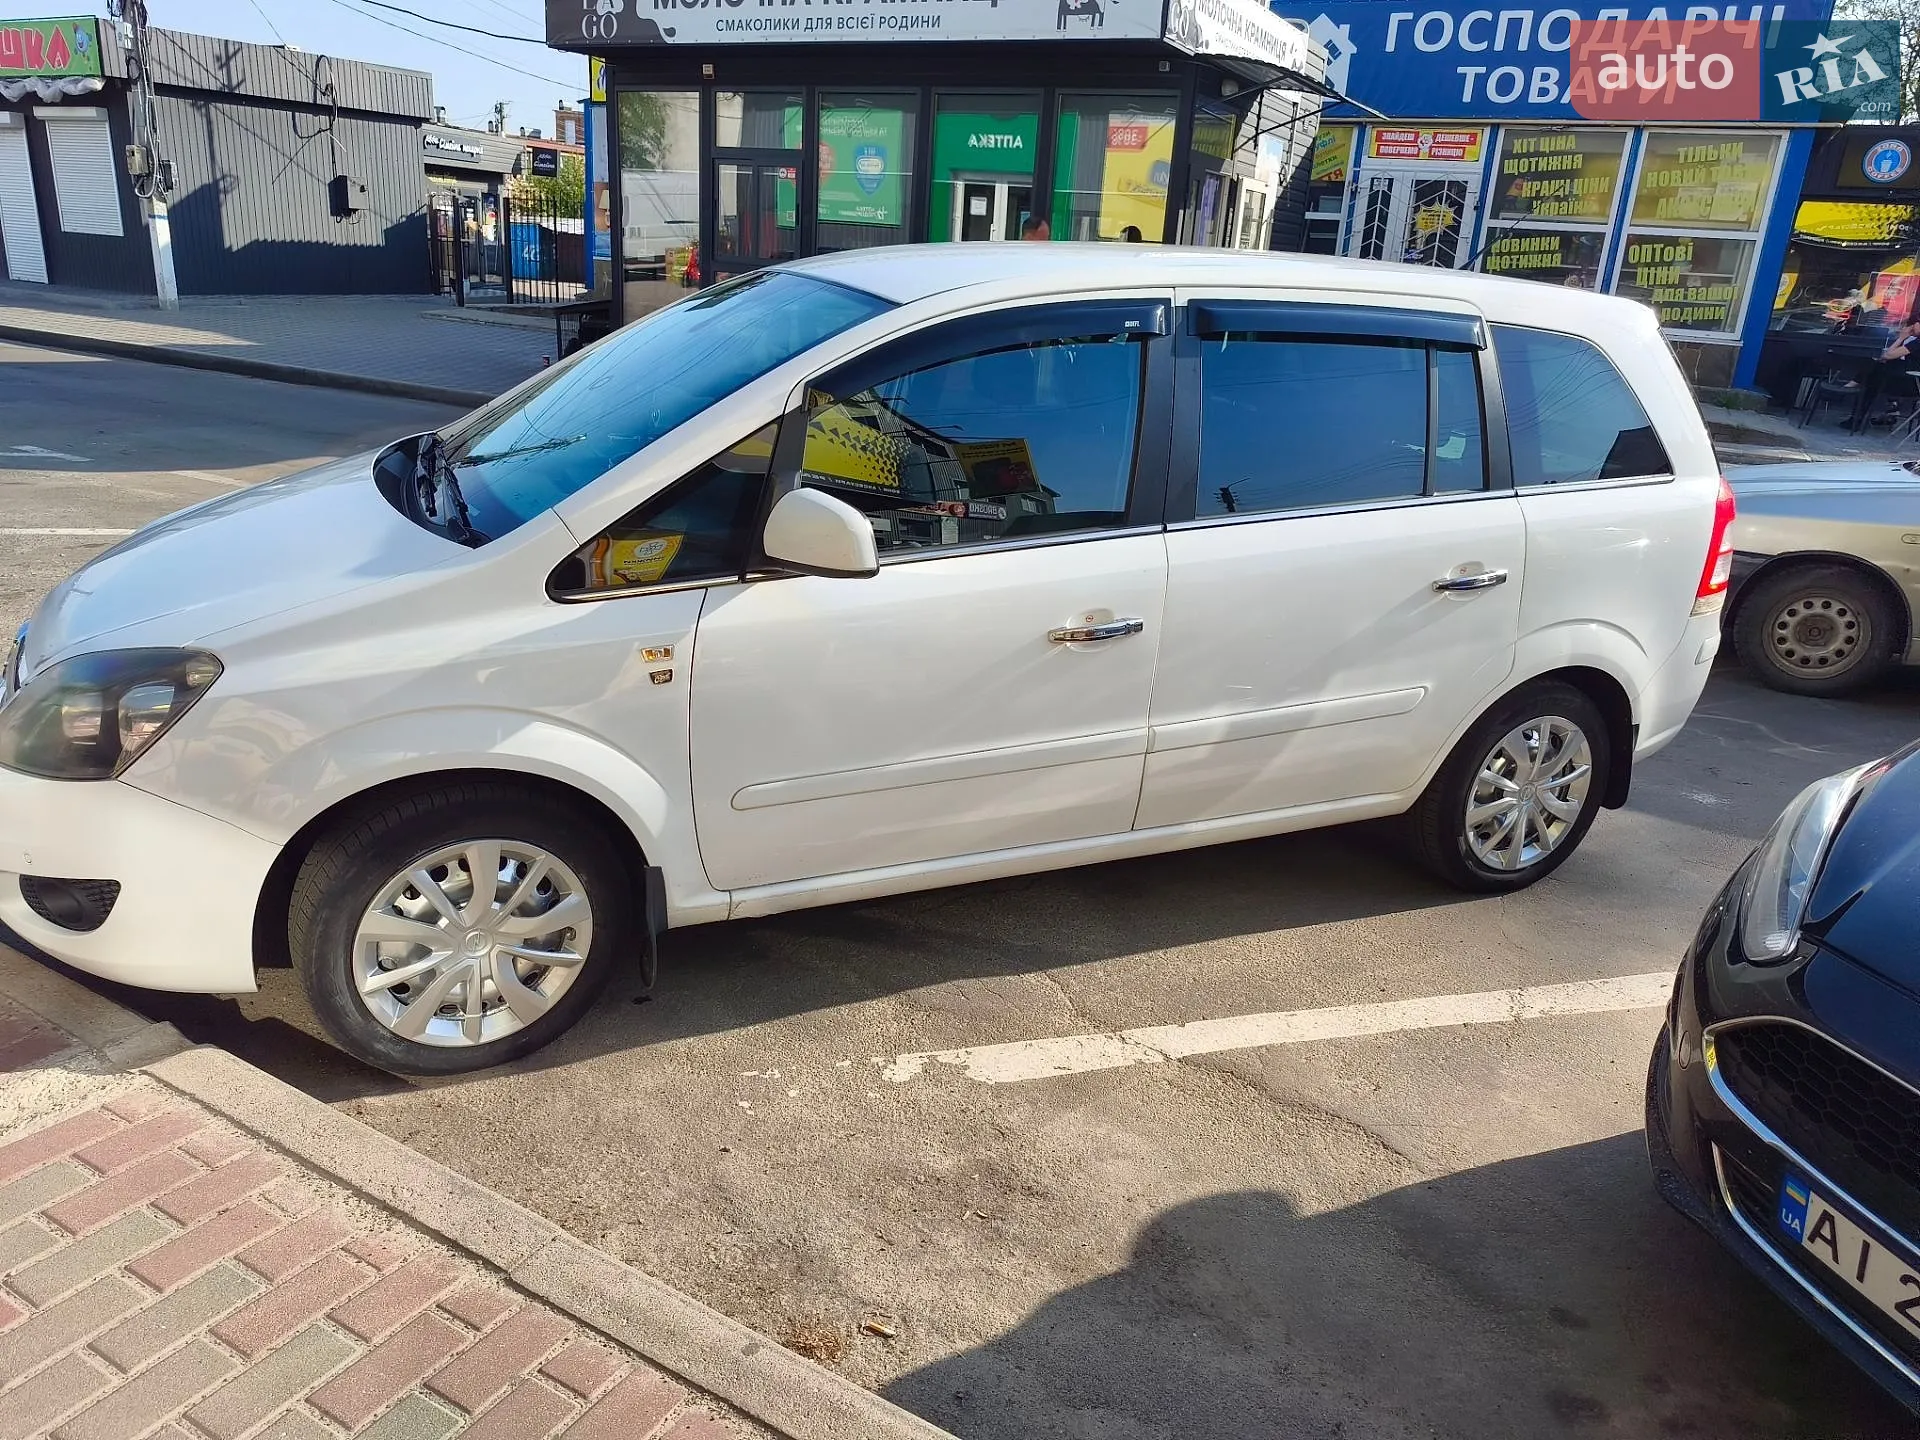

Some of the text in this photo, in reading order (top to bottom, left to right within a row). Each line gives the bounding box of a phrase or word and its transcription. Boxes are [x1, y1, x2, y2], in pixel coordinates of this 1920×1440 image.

[582, 13, 618, 40] GO
[716, 13, 941, 32] СМАКОЛИКИ ДЛЯ ВСІЄЇ РОДИНИ
[1385, 5, 1785, 61] ГОСПОДАРЧІ
[1457, 66, 1682, 105] ТОВАРИ
[1513, 135, 1577, 154] ХІТ ЦІНА
[1677, 142, 1744, 164] ТІЛЬКИ
[1503, 154, 1583, 175] ЩОТИЖНЯ
[1646, 164, 1706, 188] НОВИЙ
[1573, 177, 1610, 197] ЦІНИ
[1782, 1208, 1801, 1234] UA
